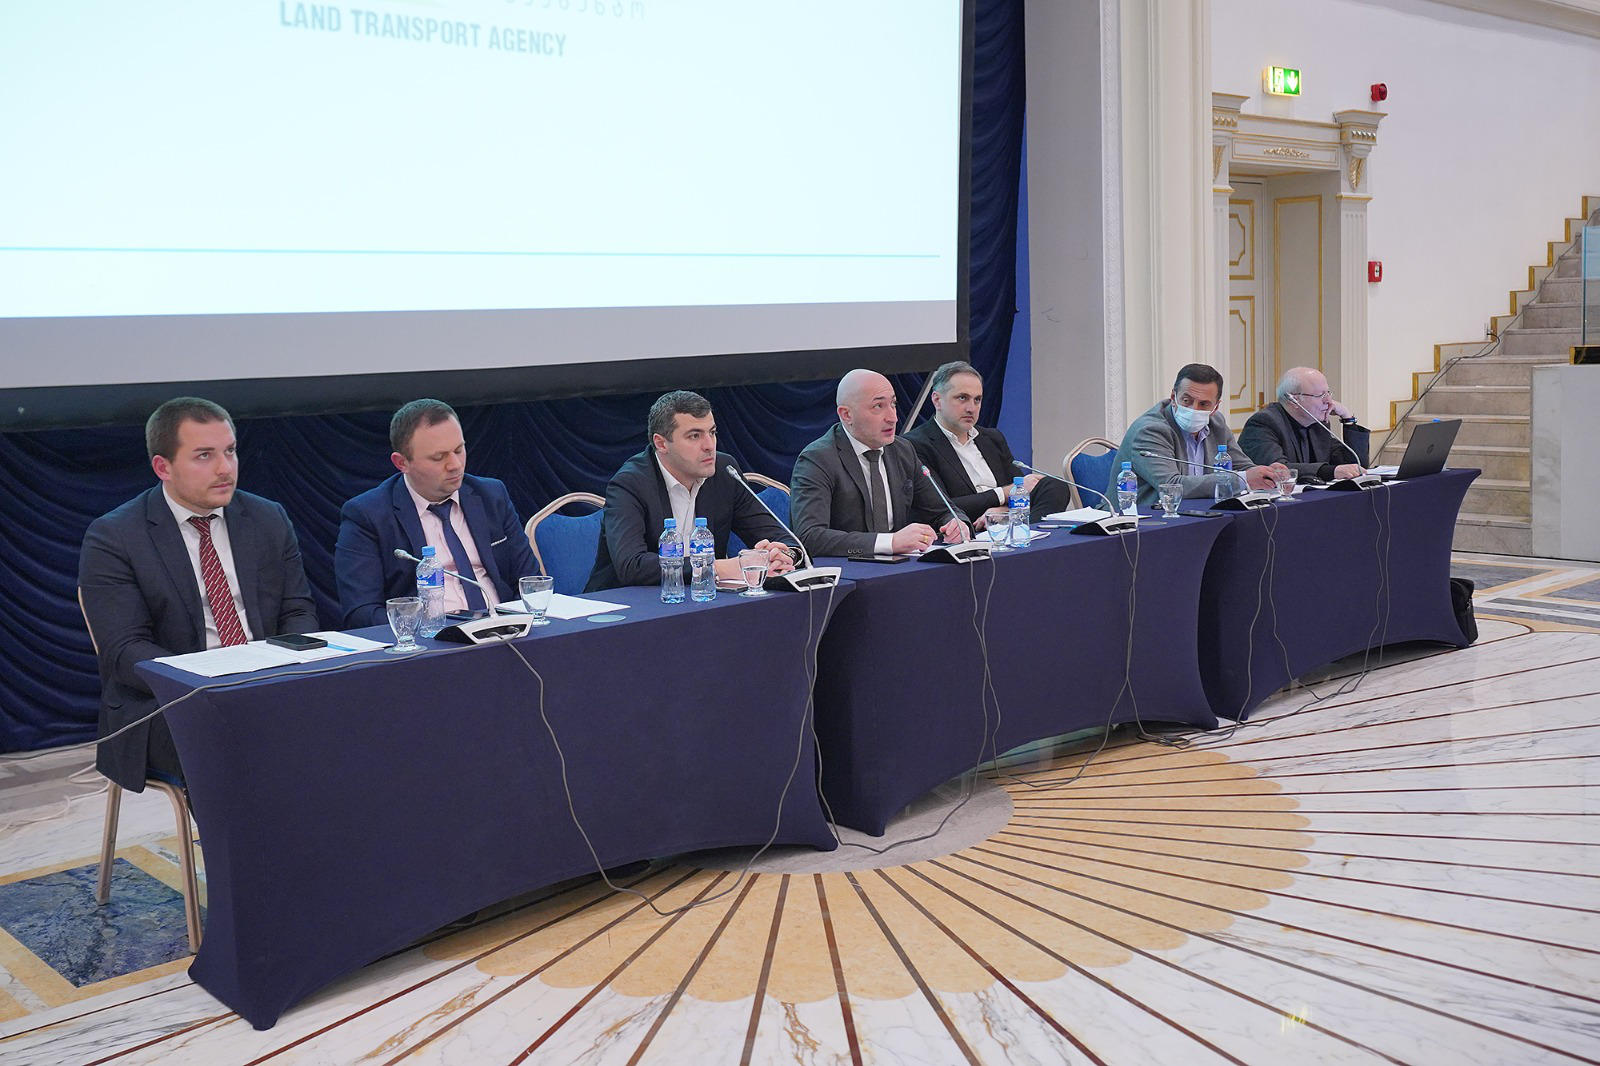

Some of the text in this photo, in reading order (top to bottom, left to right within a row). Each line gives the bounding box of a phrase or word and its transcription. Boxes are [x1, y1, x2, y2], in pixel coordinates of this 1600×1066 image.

[279, 1, 567, 58] LAND TRANSPORT AGENCY
